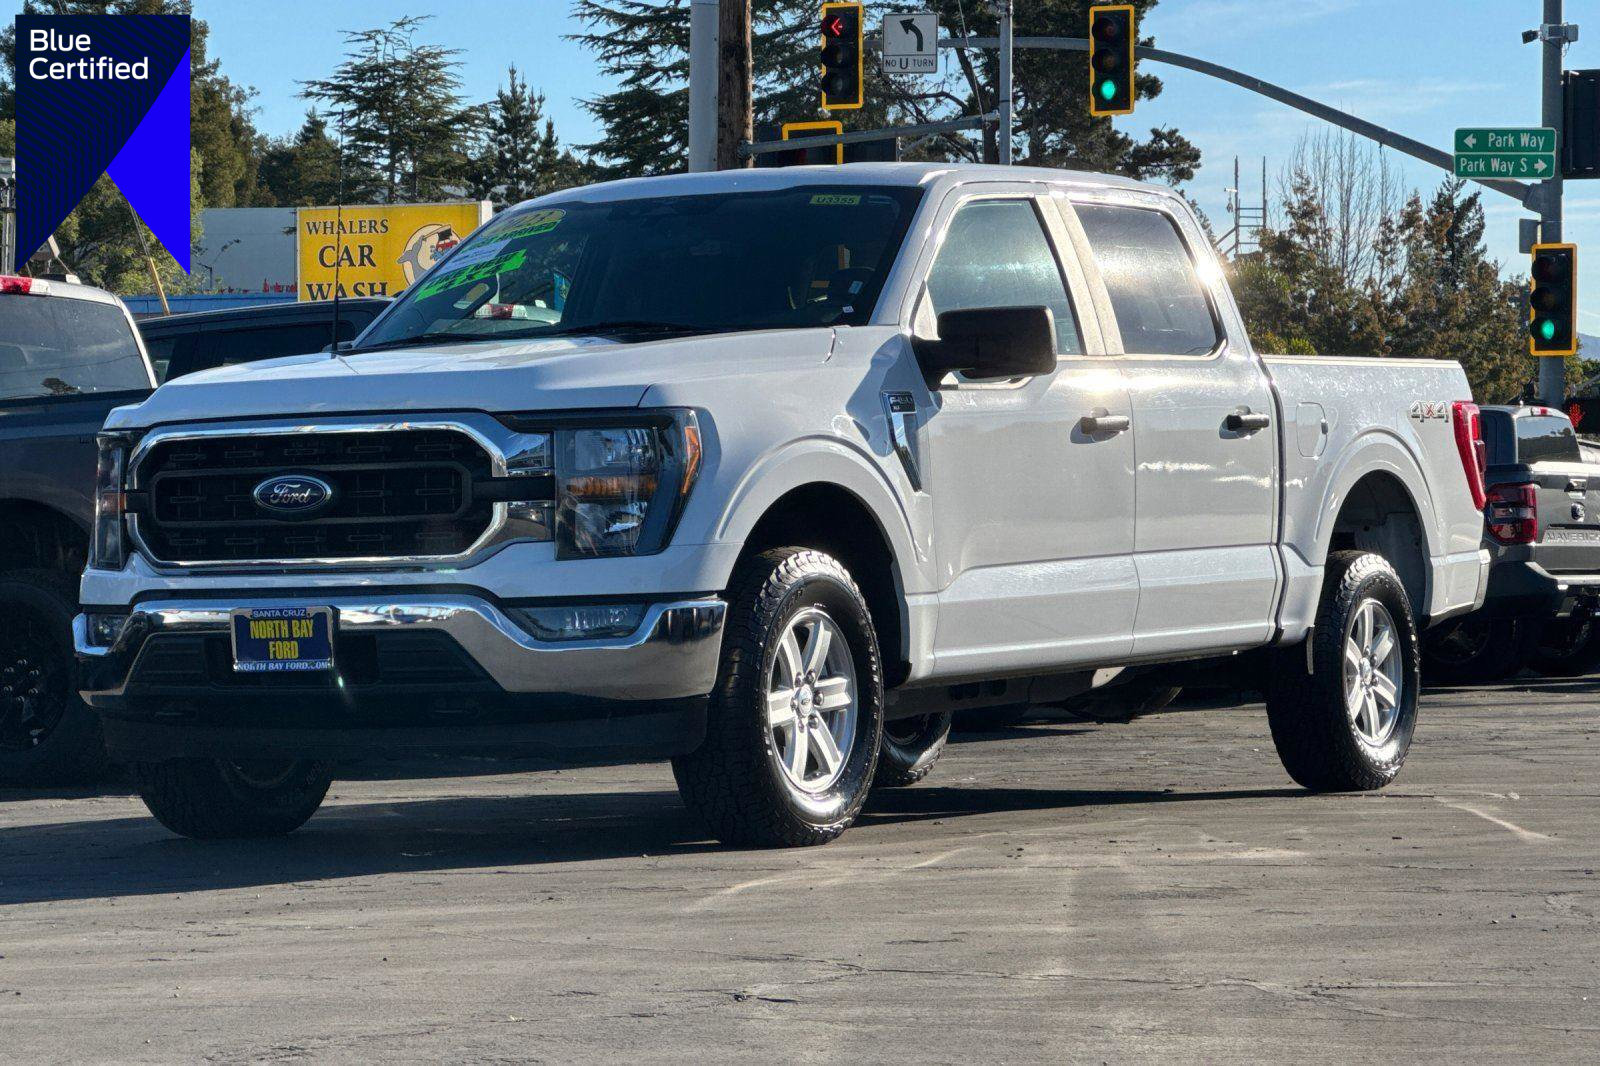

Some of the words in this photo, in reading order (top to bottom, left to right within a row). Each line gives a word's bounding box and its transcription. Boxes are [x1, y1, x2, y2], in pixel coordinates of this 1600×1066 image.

[885, 59, 897, 67] NO
[899, 58, 909, 69] U
[913, 58, 934, 67] TURN
[1488, 132, 1515, 148] Park
[1520, 132, 1545, 152] Way
[1460, 157, 1486, 172] Park
[1490, 157, 1515, 176] Way
[1520, 157, 1528, 172] S
[305, 219, 389, 235] WHALERS
[318, 244, 377, 268] CAR
[306, 282, 389, 301] WASH
[270, 483, 312, 504] Ford
[253, 609, 281, 618] SANTA
[282, 609, 306, 617] CRUZ
[250, 620, 289, 639] NORTH
[291, 618, 314, 638] BAY
[269, 640, 299, 660] FORD
[237, 662, 266, 671] NORTH
[268, 661, 283, 670] BAY
